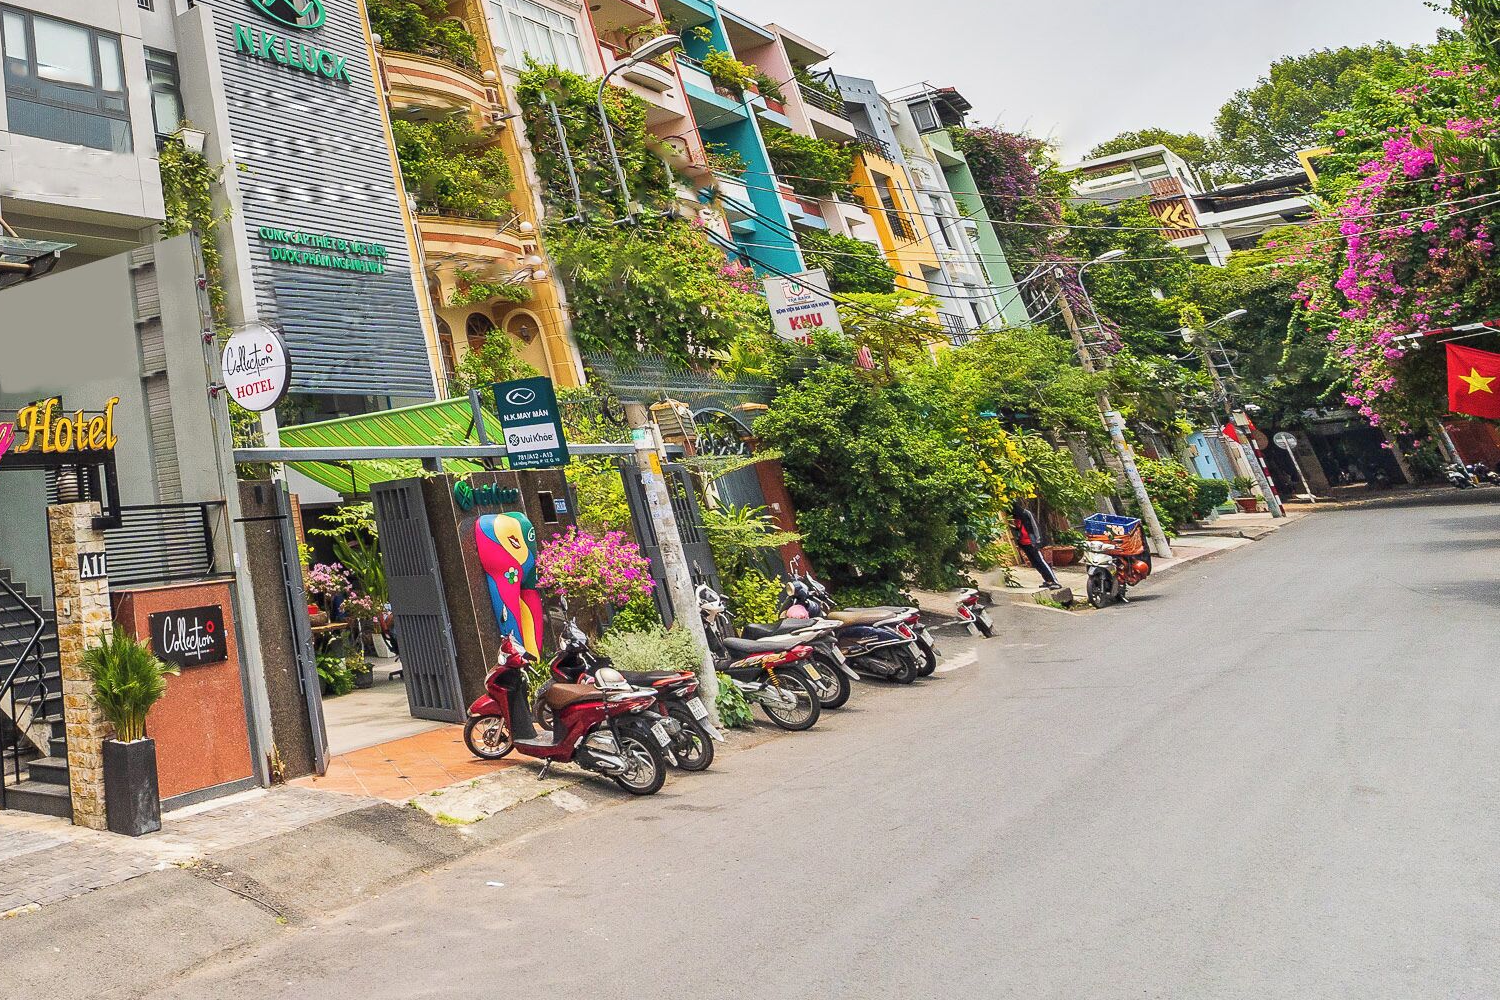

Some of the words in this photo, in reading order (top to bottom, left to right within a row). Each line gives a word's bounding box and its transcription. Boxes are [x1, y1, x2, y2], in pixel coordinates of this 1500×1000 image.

[231, 22, 352, 84] N.K.LUCK
[259, 227, 289, 243] CUNG
[789, 312, 823, 331] KHU
[227, 342, 273, 377] Collection
[236, 378, 275, 399] HOTEL
[15, 396, 120, 454] Hotel
[518, 453, 539, 461] 781/A12
[81, 554, 107, 578] A11
[163, 616, 215, 660] Collection
